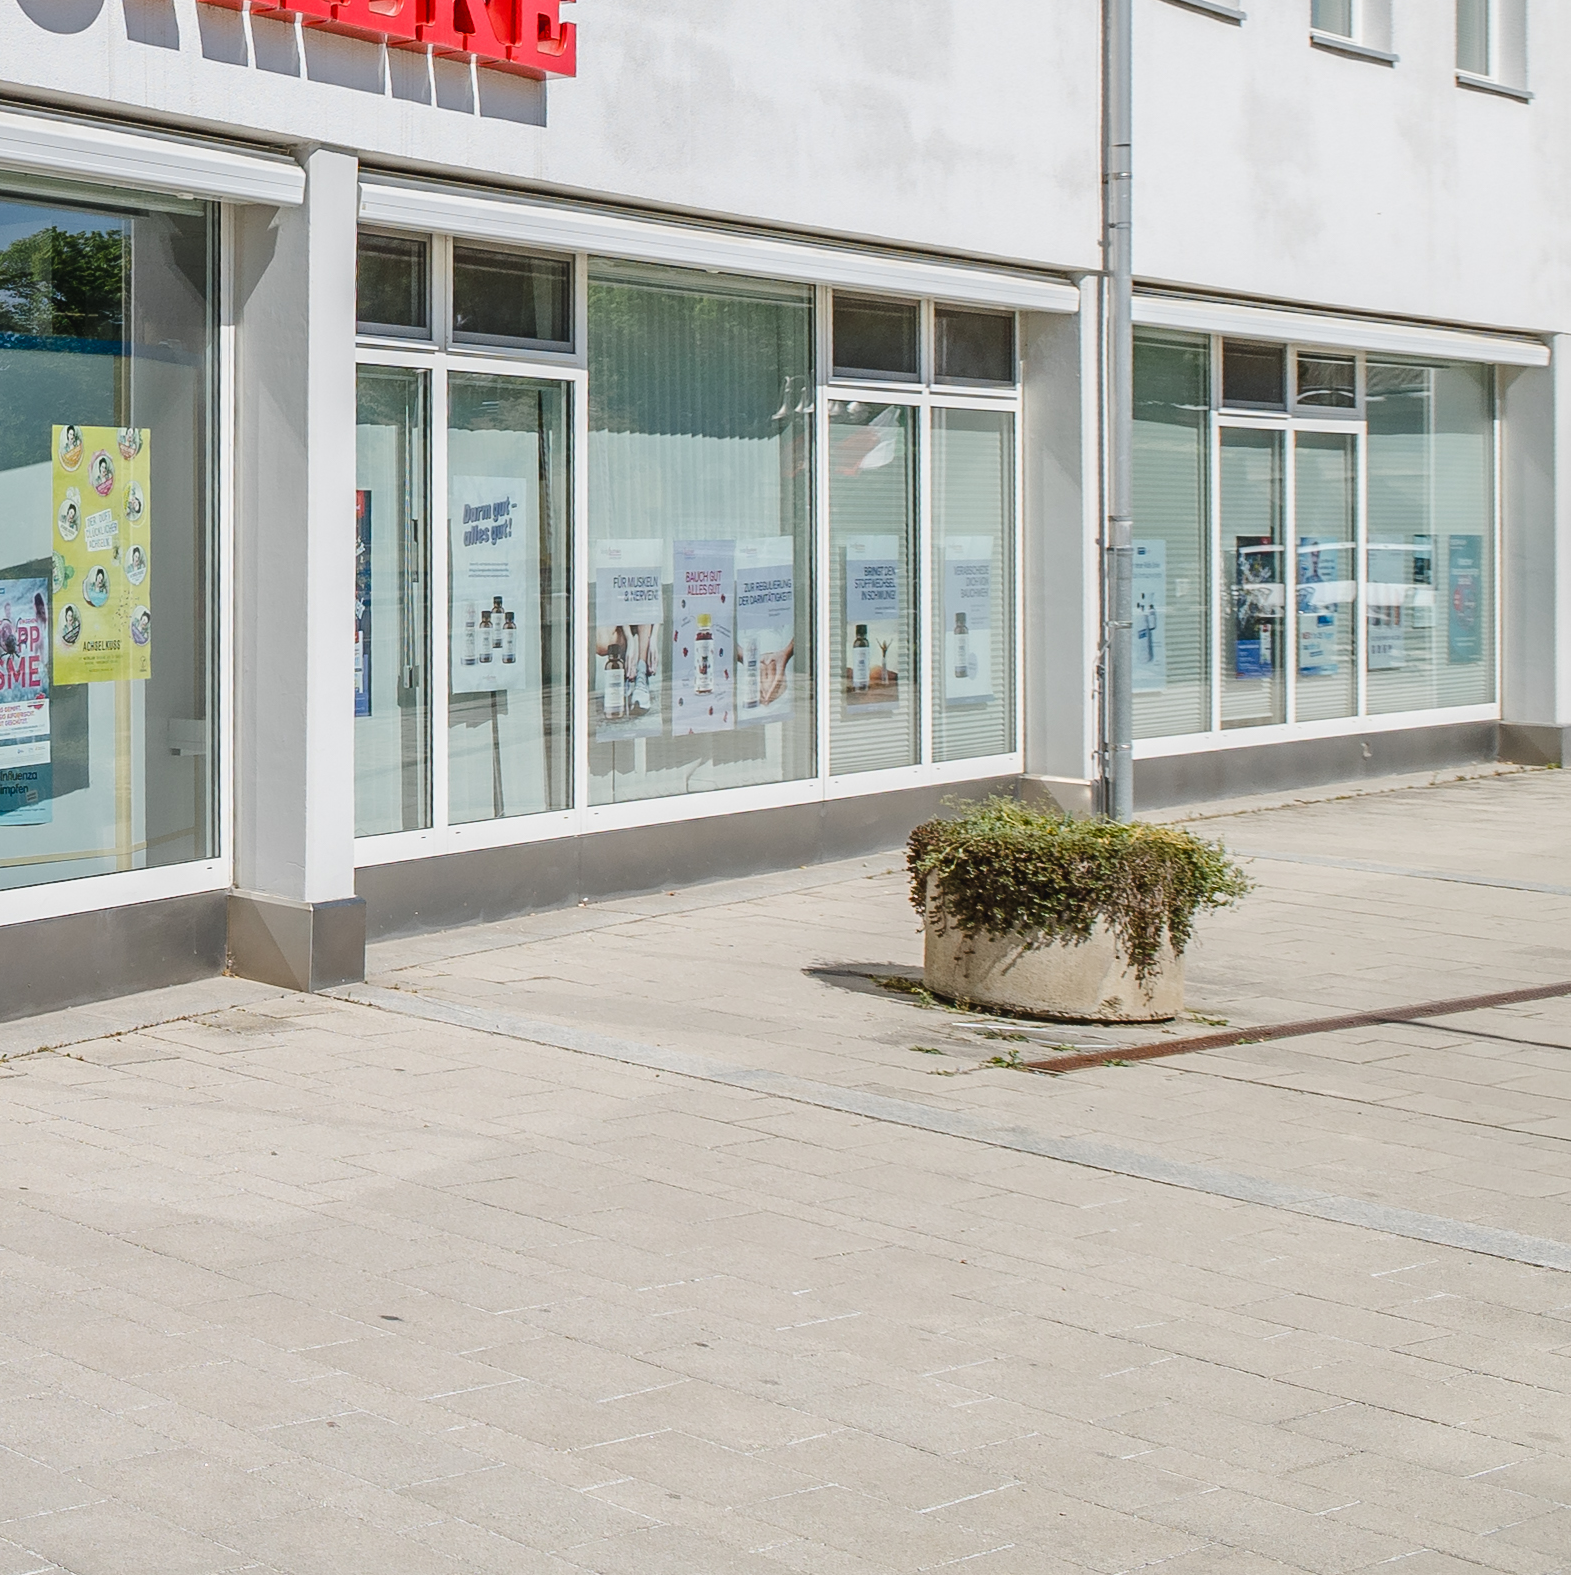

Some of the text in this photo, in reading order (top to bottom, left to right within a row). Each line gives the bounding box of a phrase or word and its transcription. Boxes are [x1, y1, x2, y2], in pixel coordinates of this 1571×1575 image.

[463, 496, 510, 524] Darm gut
[464, 518, 513, 546] alles gut!
[627, 576, 658, 588] MUSKELN
[685, 570, 722, 583] BAUCH GUT
[687, 584, 707, 595] ALLES
[743, 582, 755, 593] ZUR
[0, 771, 38, 781] Influenza
[0, 784, 29, 796] impfen
